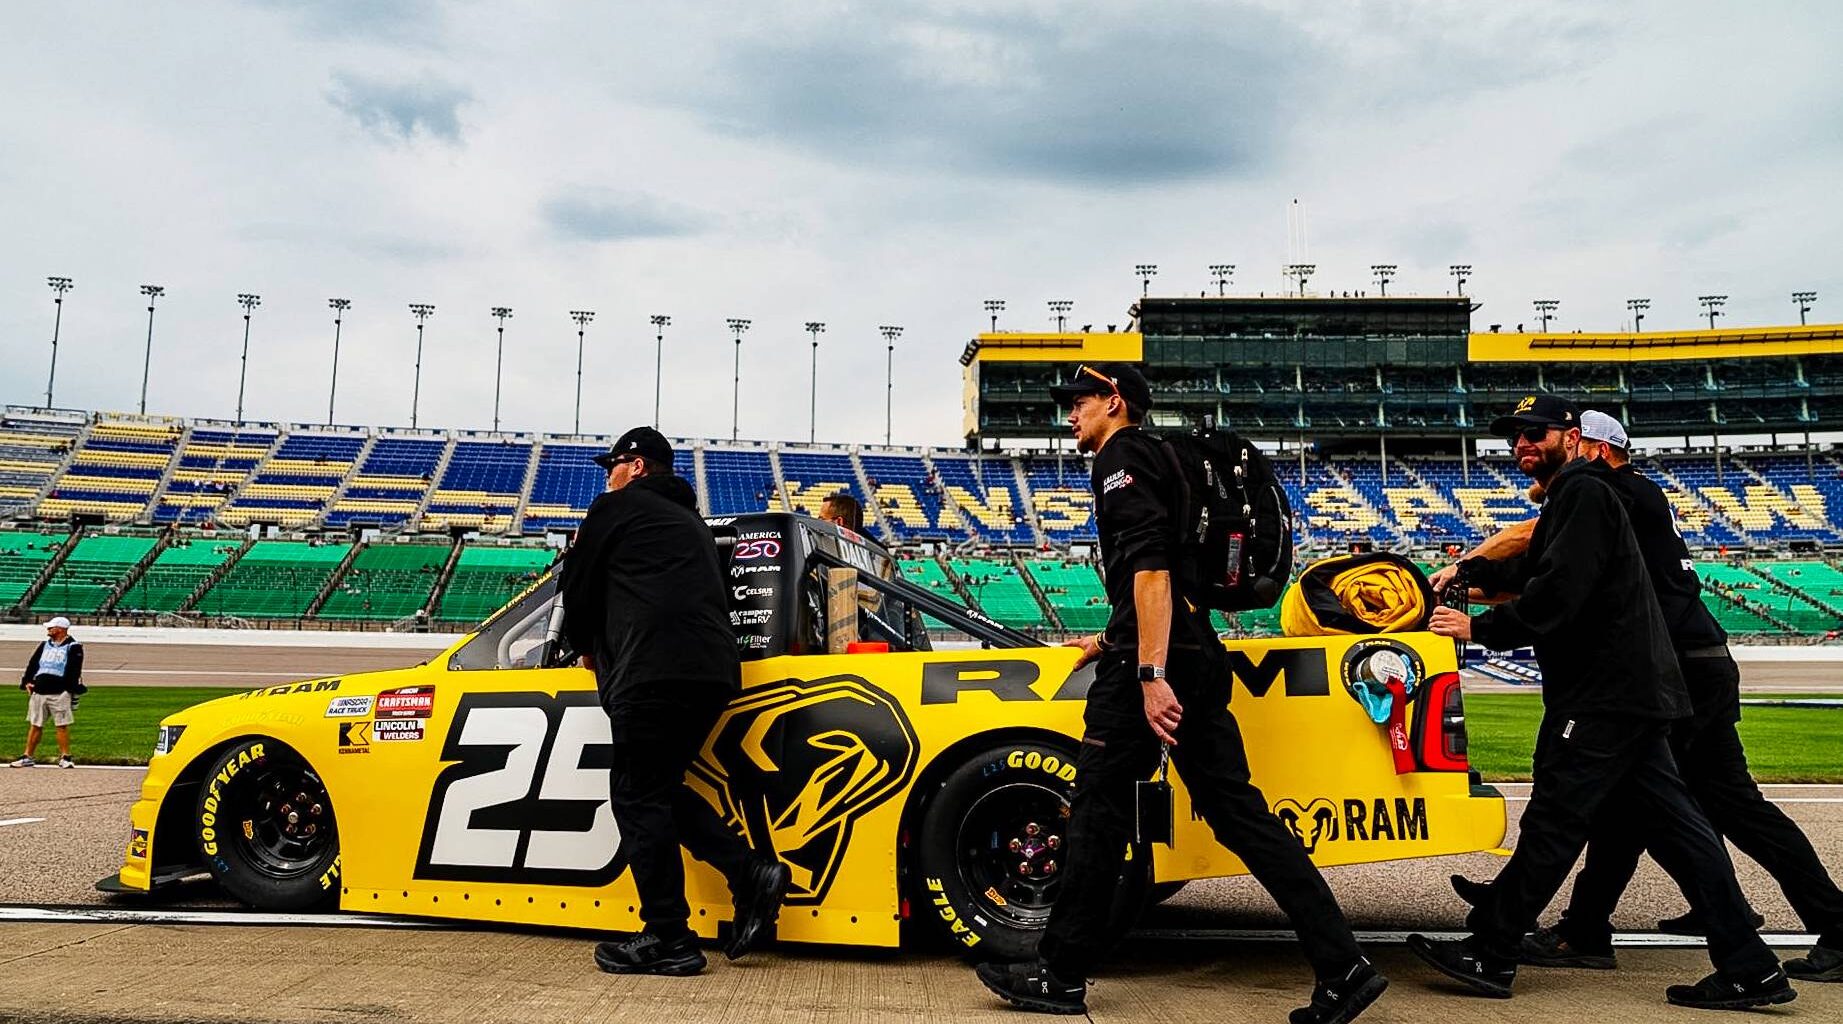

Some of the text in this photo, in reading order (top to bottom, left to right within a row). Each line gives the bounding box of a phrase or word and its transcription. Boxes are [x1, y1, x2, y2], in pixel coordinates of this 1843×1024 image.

[766, 481, 1096, 529] KANS
[739, 531, 782, 541] AMERICA
[735, 540, 780, 559] 250
[745, 587, 774, 596] CELSIUS
[921, 647, 1331, 705] RM
[328, 706, 346, 714] RACE
[379, 696, 431, 708] CRAFTSMAN
[375, 721, 416, 731] LINCOLN
[383, 731, 420, 740] WELDERS
[429, 706, 621, 872] 25
[202, 743, 265, 856] GOODYEAR
[1343, 797, 1429, 841] RAM
[926, 877, 982, 948] EAGLE
